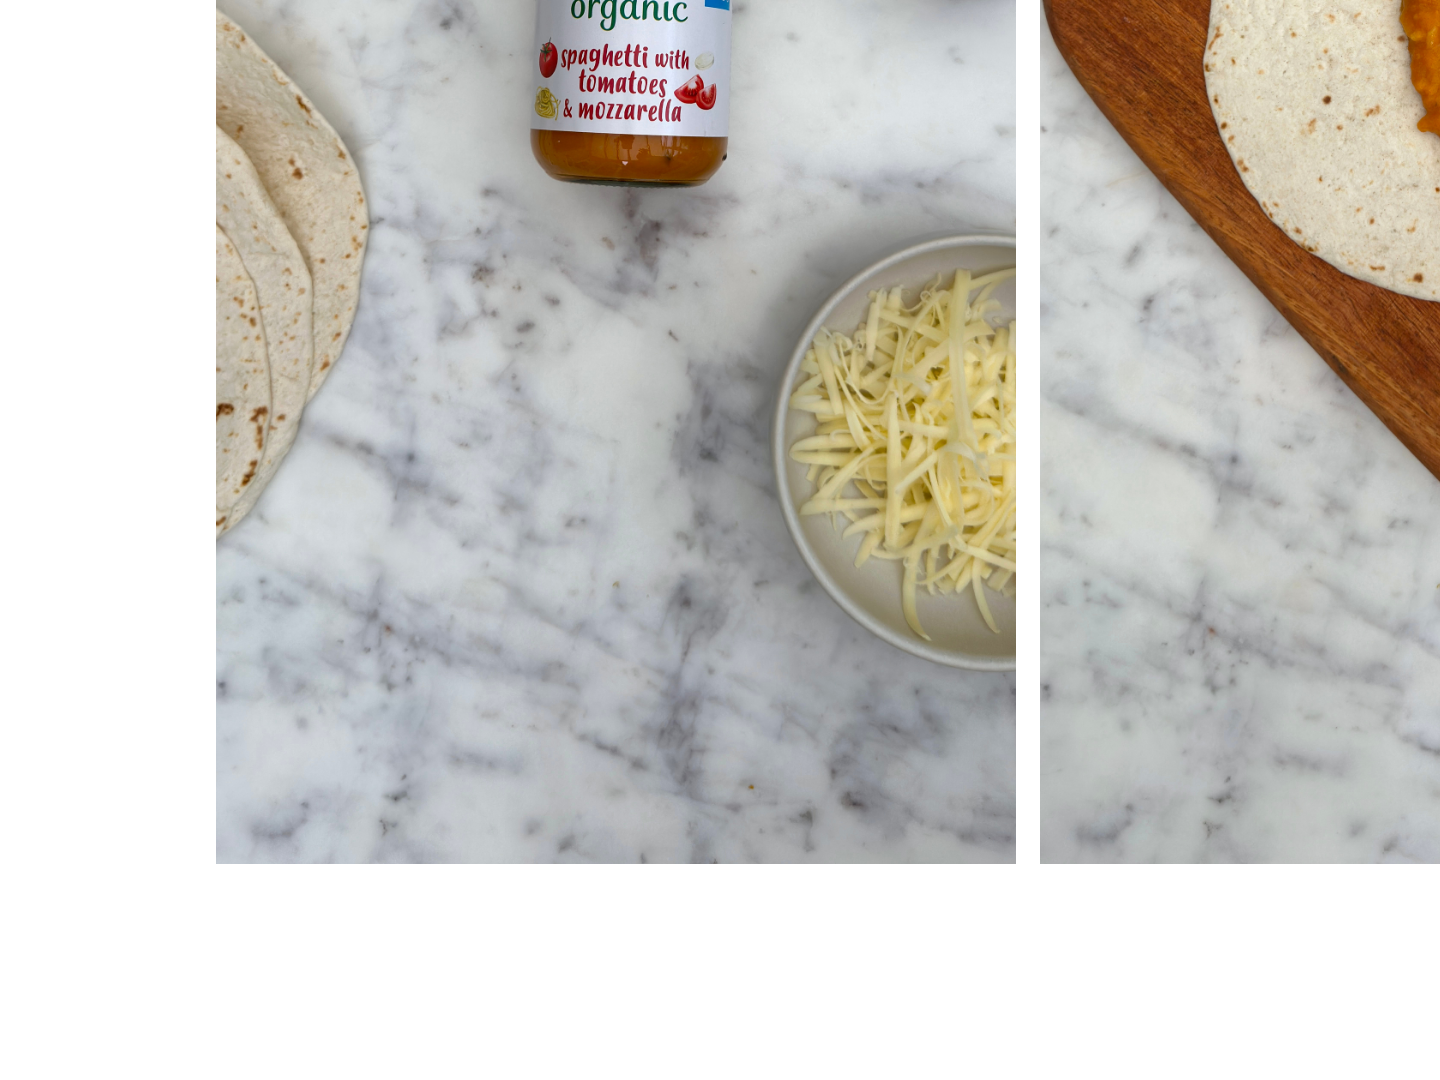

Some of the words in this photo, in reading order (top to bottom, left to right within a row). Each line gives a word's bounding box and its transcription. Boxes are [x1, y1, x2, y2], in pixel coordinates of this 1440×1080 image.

[561, 43, 648, 72] spaghetti
[654, 49, 690, 70] with
[578, 68, 668, 98] tomatoes
[563, 98, 573, 118] &
[578, 98, 682, 122] mozzarella
